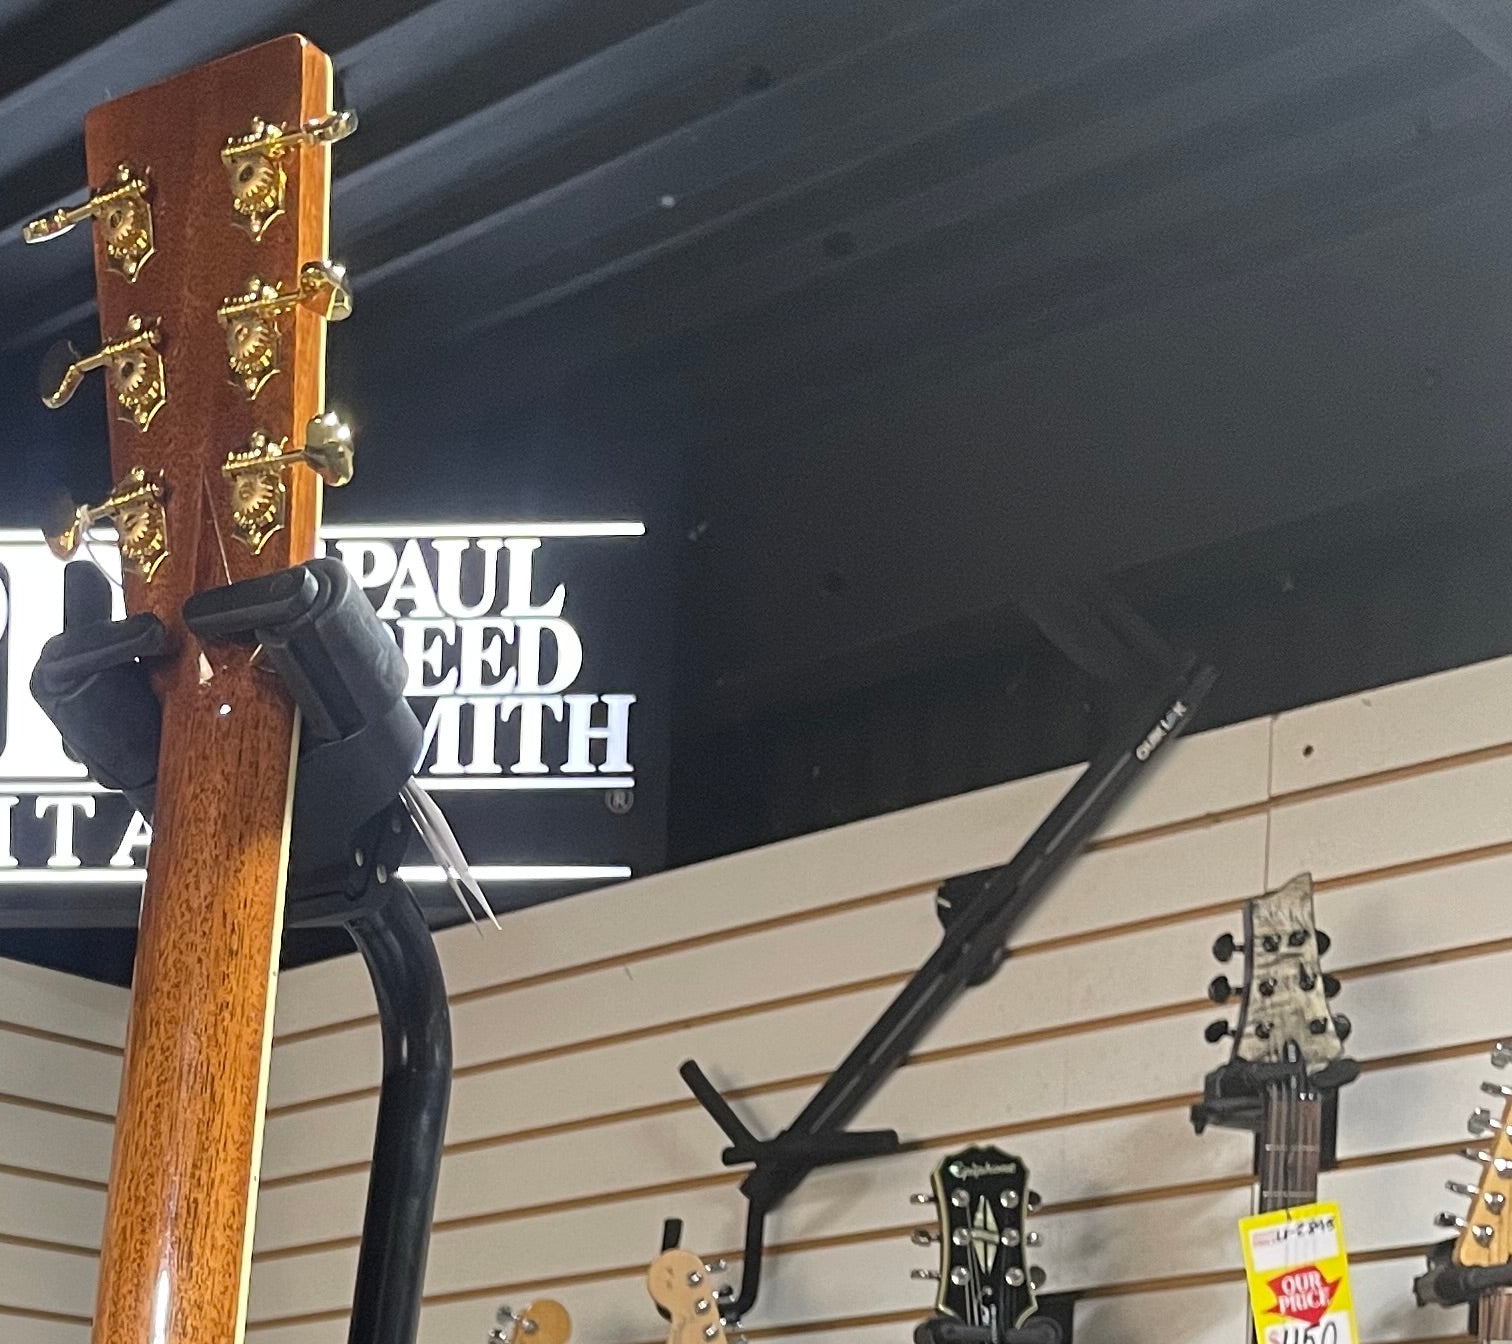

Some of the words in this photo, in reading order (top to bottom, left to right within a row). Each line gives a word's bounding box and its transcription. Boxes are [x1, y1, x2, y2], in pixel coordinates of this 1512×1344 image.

[334, 537, 567, 619] PAUL
[386, 618, 584, 696] EED
[1278, 1286, 1331, 1314] PRICE
[1281, 1269, 1322, 1295] OUR
